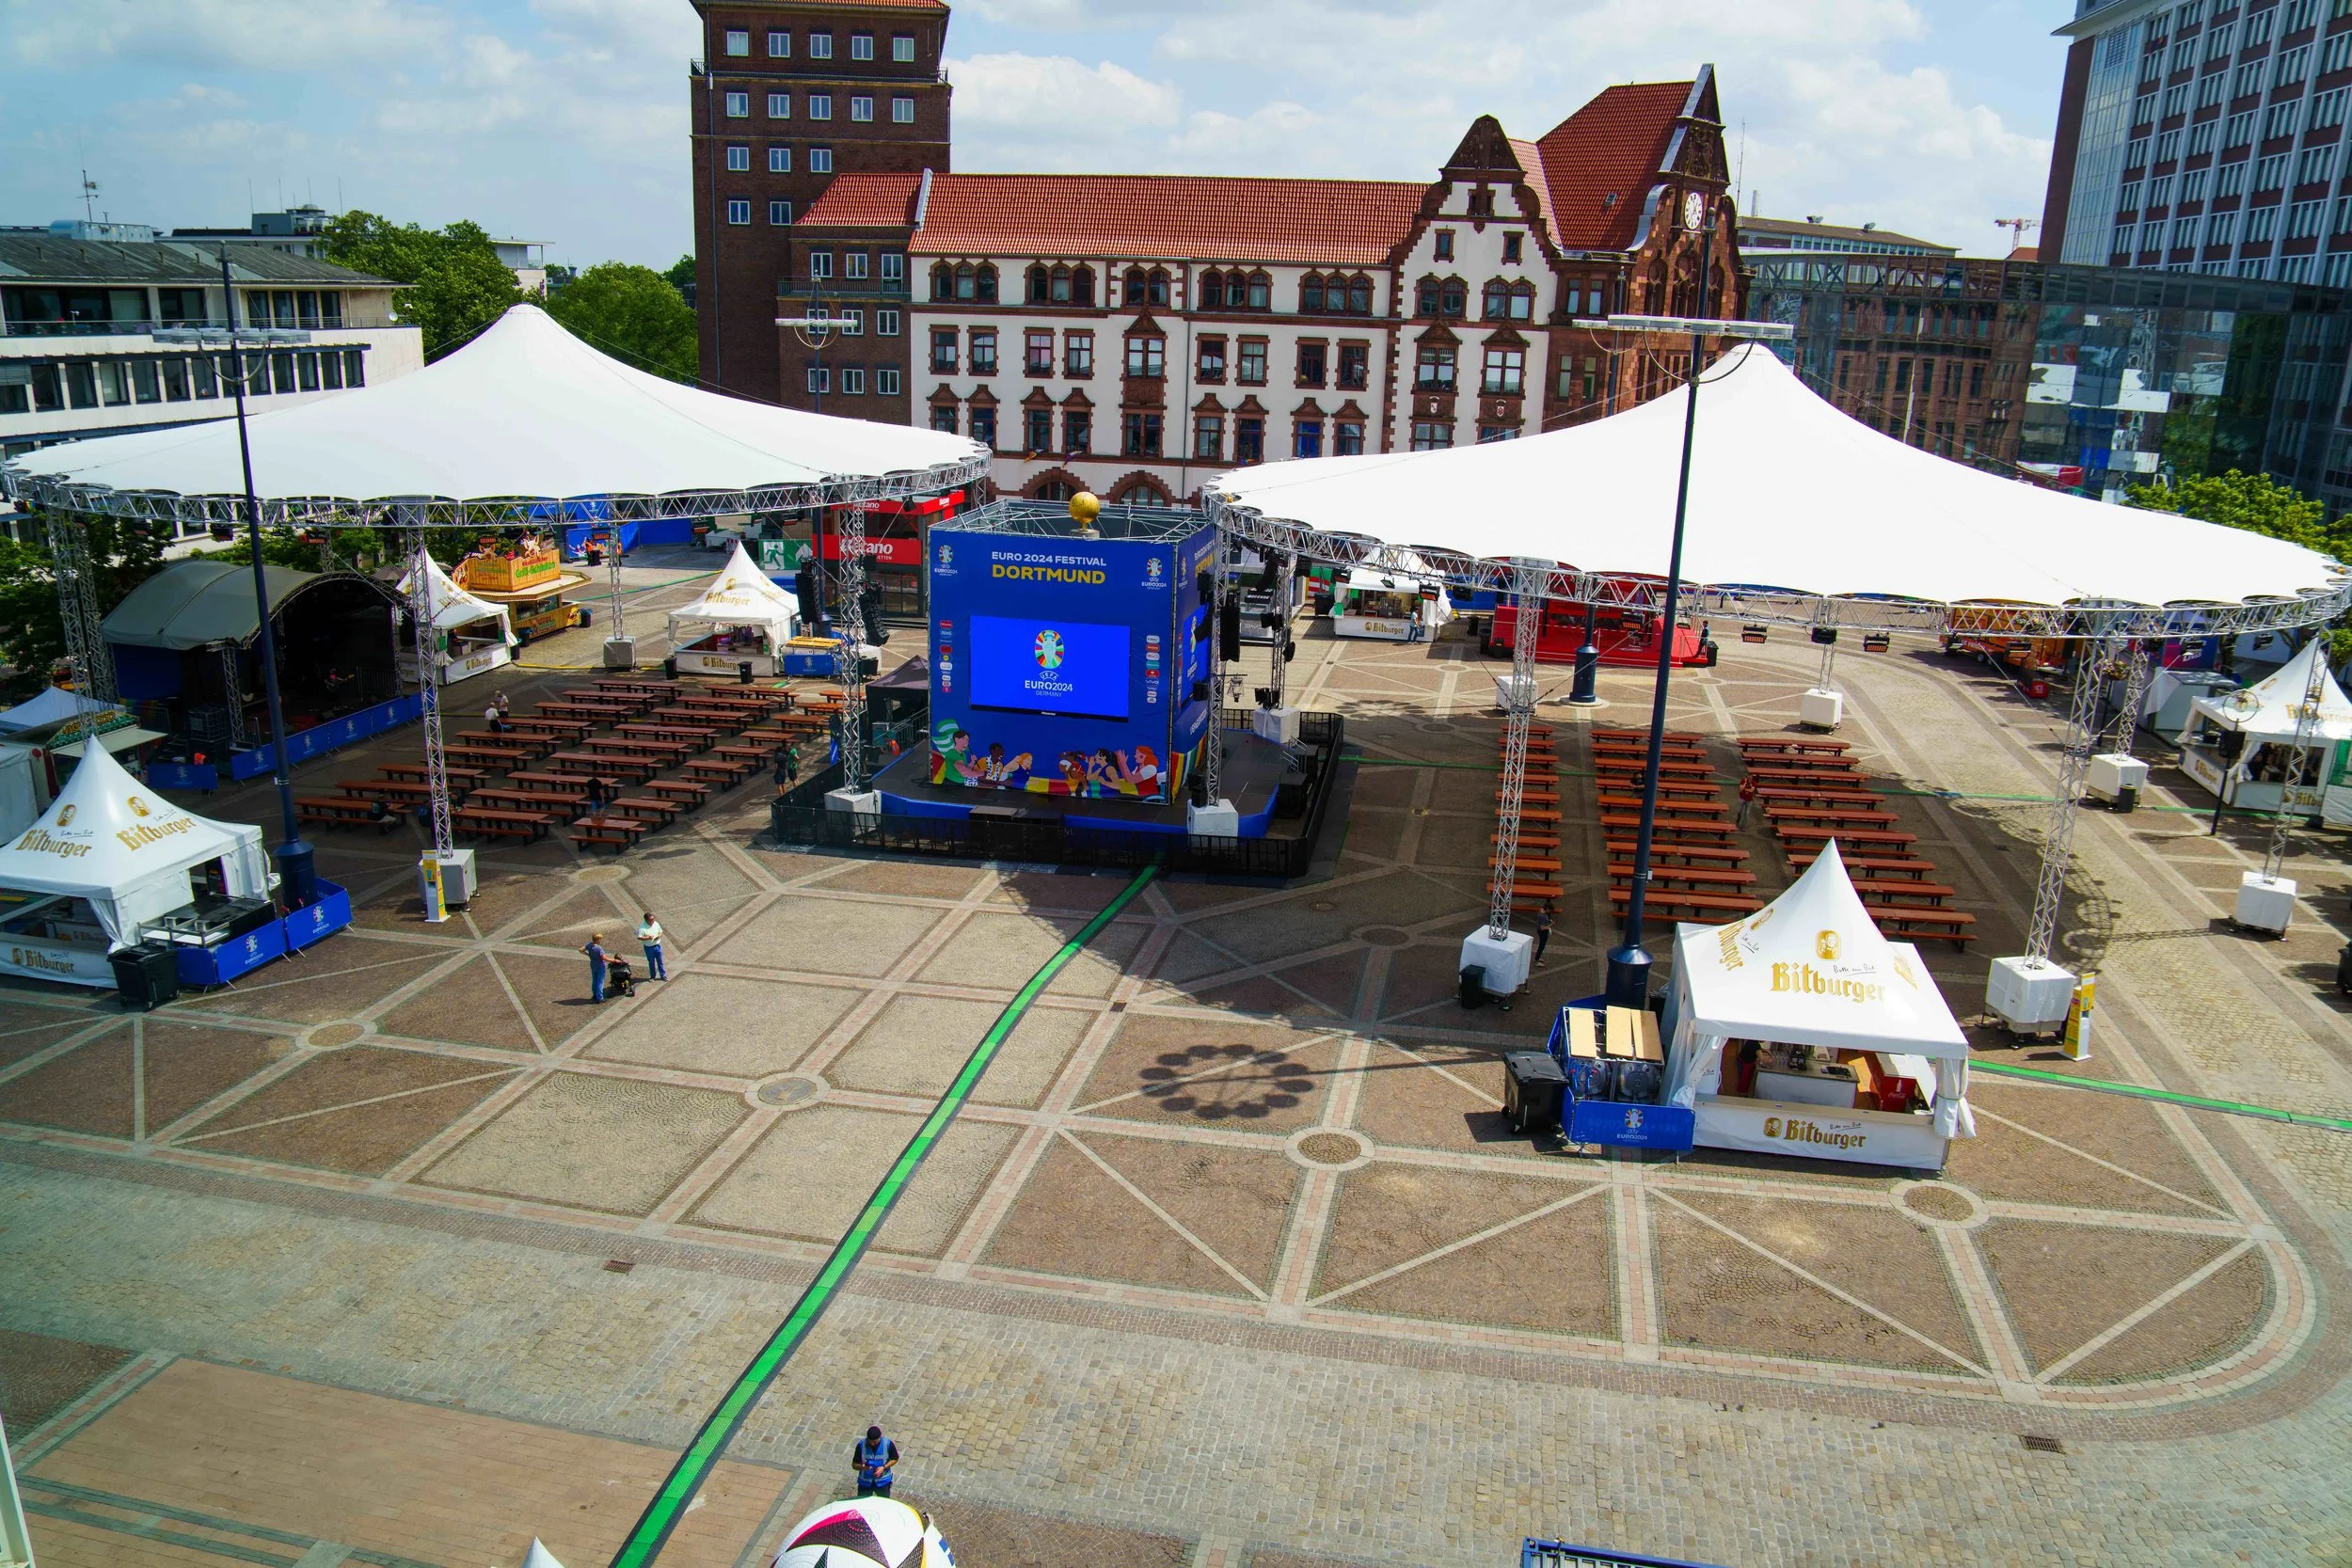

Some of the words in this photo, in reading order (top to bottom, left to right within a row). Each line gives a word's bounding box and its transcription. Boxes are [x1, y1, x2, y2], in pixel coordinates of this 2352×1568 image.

[992, 551, 1023, 562] EURO
[1024, 553, 1054, 564] 2024
[1055, 555, 1107, 566] FESTIVAL
[992, 564, 1106, 585] DORTMUND
[704, 592, 751, 606] Bitburger
[1373, 622, 1405, 636] Bitburger
[1025, 679, 1073, 691] EURO2024
[1036, 689, 1062, 698] GERMANY
[15, 829, 92, 858] Bitburger
[117, 816, 197, 851] Bitburger
[24, 949, 75, 974] Bitburger
[1770, 961, 1885, 1004] Bitburger
[1784, 1118, 1867, 1149] Bitburger
